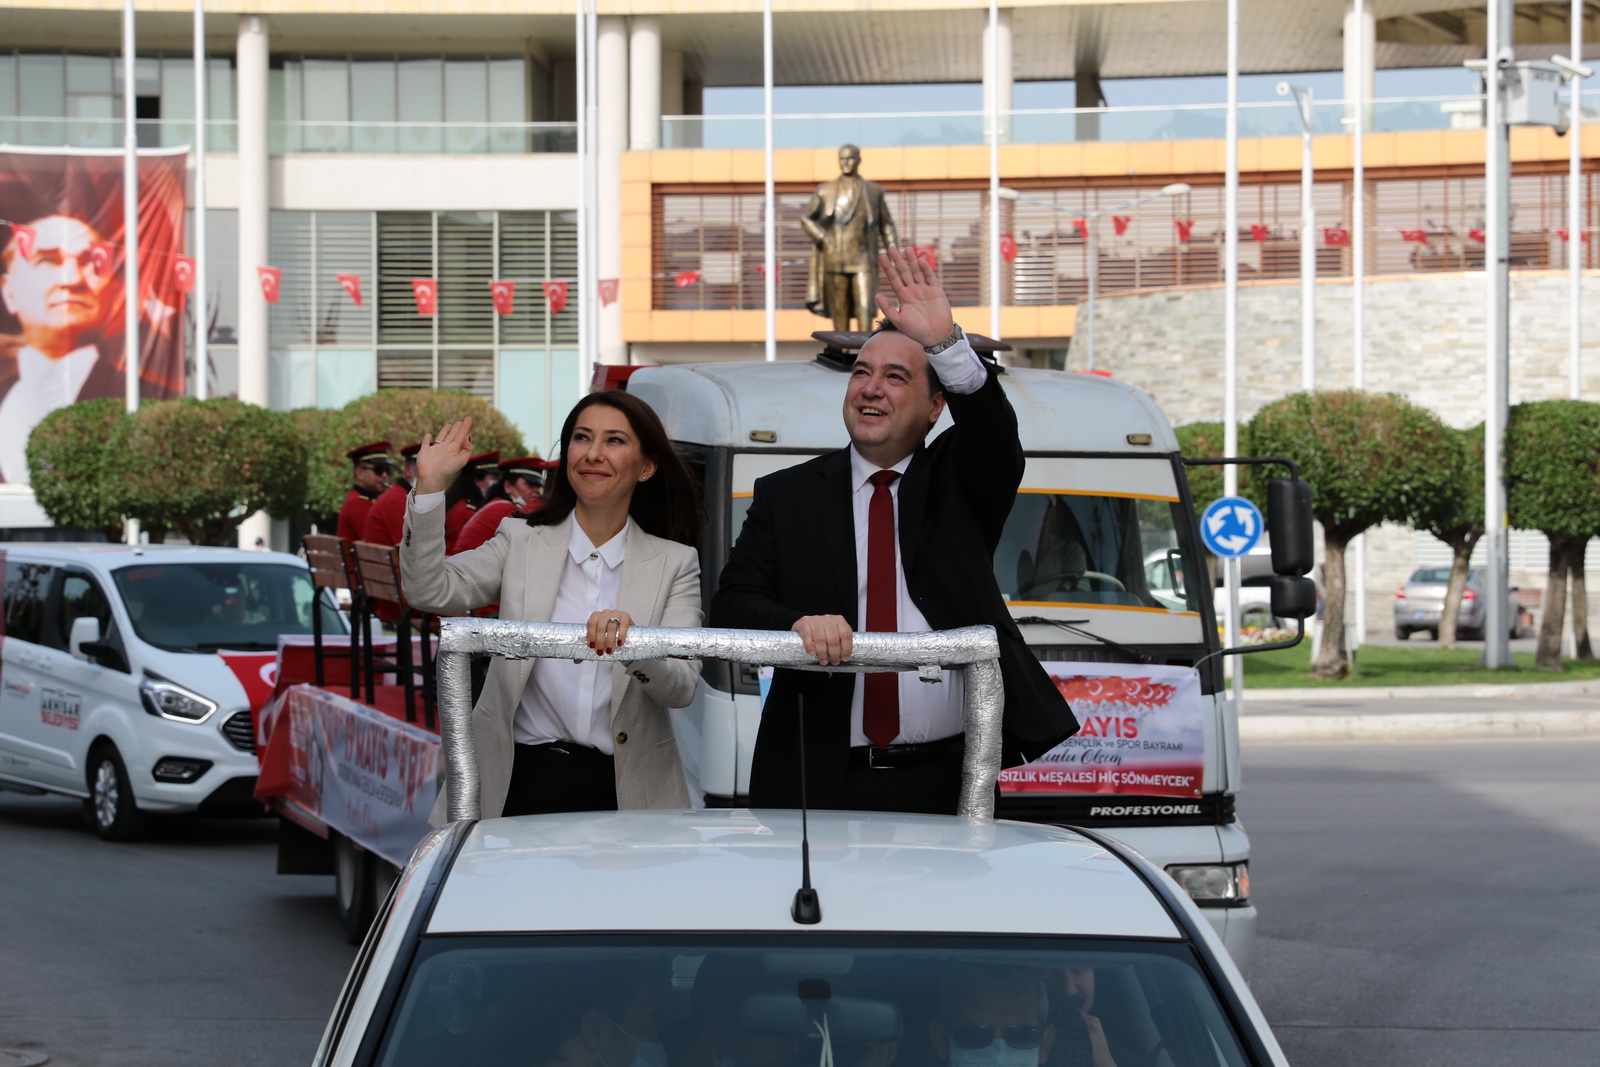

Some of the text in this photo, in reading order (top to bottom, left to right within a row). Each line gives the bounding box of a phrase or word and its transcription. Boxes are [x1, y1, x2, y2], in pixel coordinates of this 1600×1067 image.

[1072, 716, 1138, 739] AYIS
[1117, 739, 1141, 750] SPOR
[1143, 740, 1184, 751] BAYRAMI
[1080, 748, 1122, 766] Olsun
[997, 770, 1037, 783] SIZLIK
[1039, 769, 1096, 786] MEŞALESİ
[1098, 770, 1120, 787] HİÇ
[1090, 805, 1202, 816] PROFESYONEL
